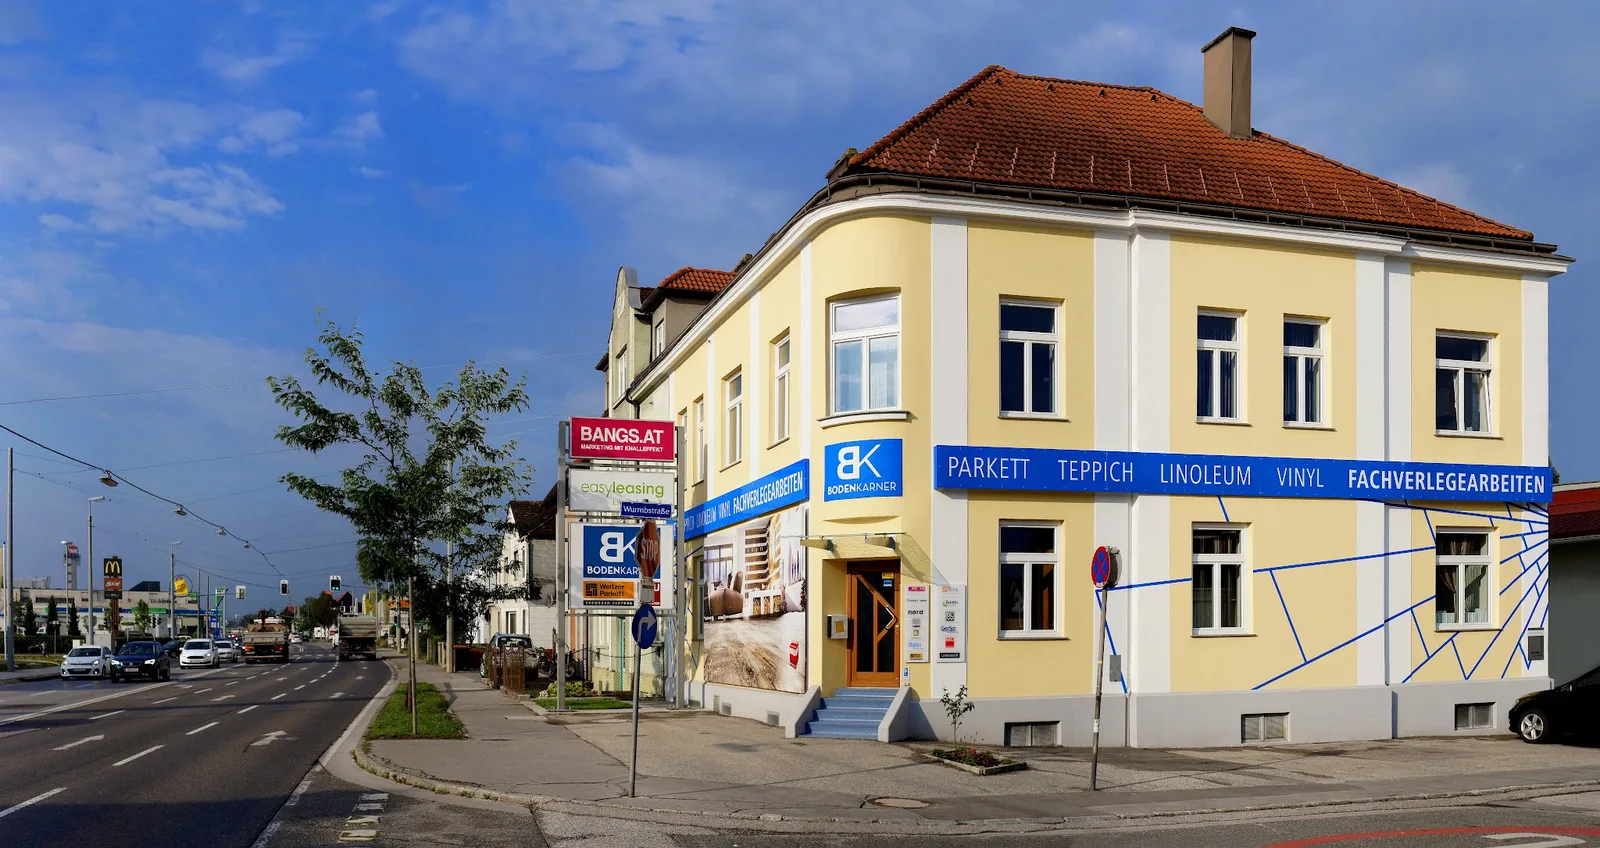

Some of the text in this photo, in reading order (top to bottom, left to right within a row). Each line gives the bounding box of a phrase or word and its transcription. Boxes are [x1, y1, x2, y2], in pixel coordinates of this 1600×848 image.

[580, 425, 664, 444] BANGS.AT
[580, 443, 613, 451] MARKETING
[624, 445, 664, 453] KNALLEFFEKT
[837, 444, 882, 480] BK
[948, 456, 1545, 494] PARKETT TEPPICH LINOLEUM VINYL FACHVERLEGEARBEITEN
[581, 481, 665, 498] easyleasing
[733, 470, 804, 514] FACHVERLEGEARBEITEN
[827, 480, 897, 496] BODENKARNER
[622, 505, 671, 515] Wurmbstraße
[640, 538, 659, 562] STOP
